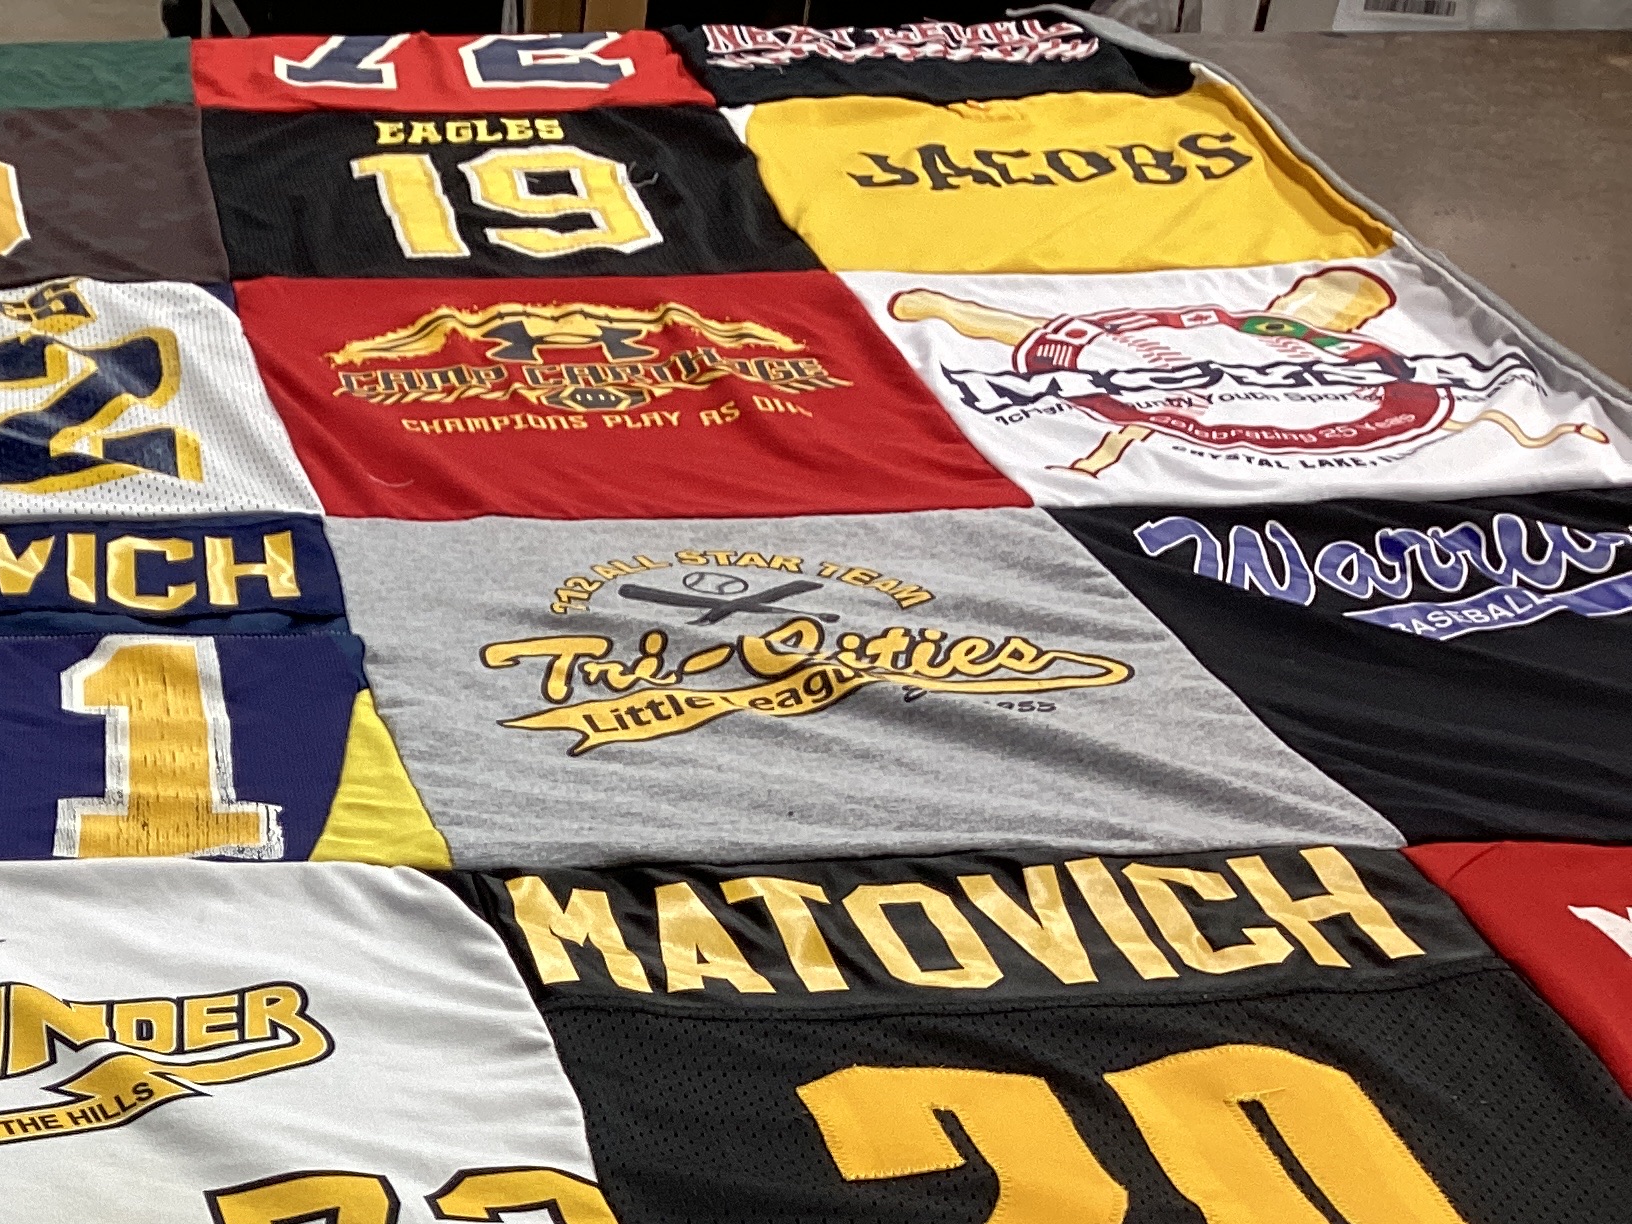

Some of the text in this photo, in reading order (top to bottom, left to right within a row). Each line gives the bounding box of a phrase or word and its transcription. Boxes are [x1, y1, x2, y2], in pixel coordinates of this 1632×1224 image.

[374, 118, 564, 145] EAGLES
[846, 133, 1254, 191] JACOBS
[349, 144, 664, 259] 19
[338, 362, 506, 395] CAMP
[401, 415, 589, 434] CHAMPIONS
[604, 410, 682, 430] PLAY
[699, 401, 743, 427] AS
[1317, 425, 1358, 441] 25
[590, 551, 672, 581] ALL
[674, 549, 804, 573] STAR
[817, 560, 937, 611] TEAM
[503, 846, 1427, 994] MATOVICH
[65, 1081, 155, 1127] HILLS
